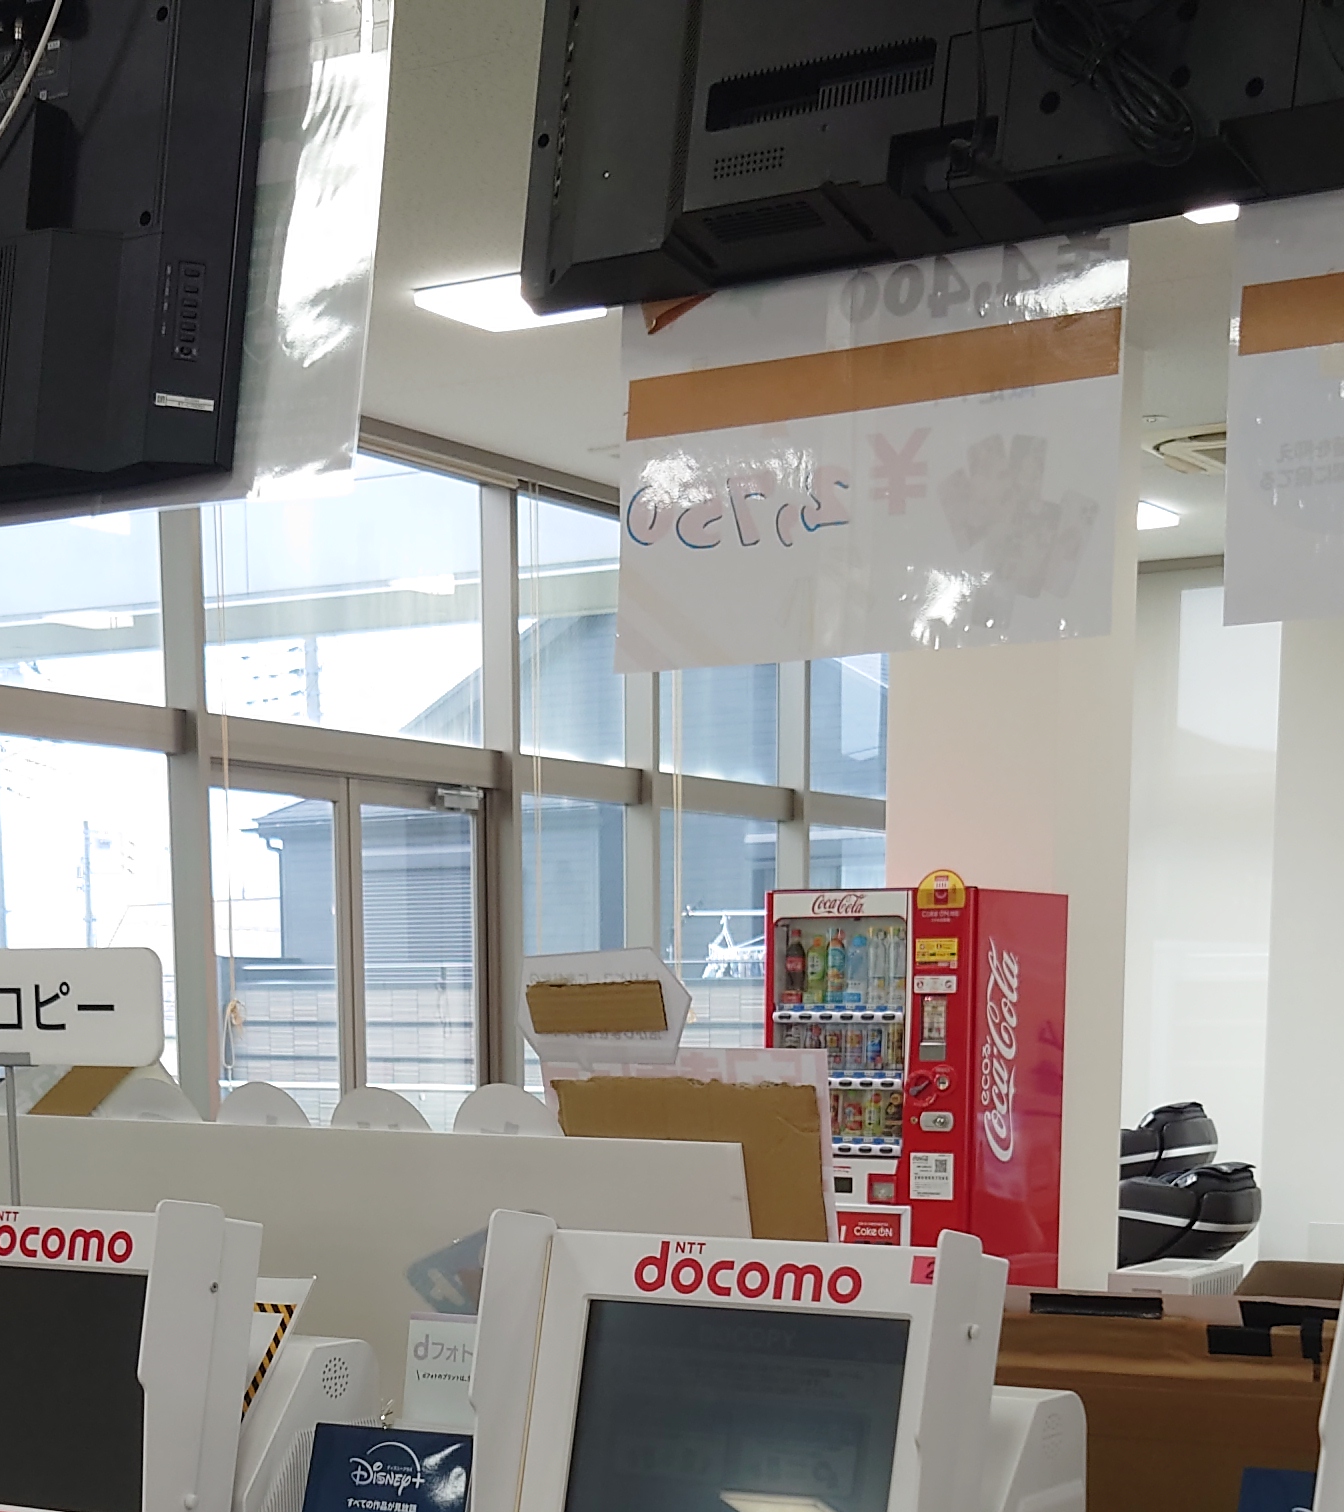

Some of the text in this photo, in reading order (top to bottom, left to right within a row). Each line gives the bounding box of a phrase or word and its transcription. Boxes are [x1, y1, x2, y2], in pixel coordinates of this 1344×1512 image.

[854, 1227, 877, 1238] Coke
[675, 1242, 706, 1255] NTT
[634, 1241, 862, 1304] docomo
[413, 1334, 474, 1363] dフォト
